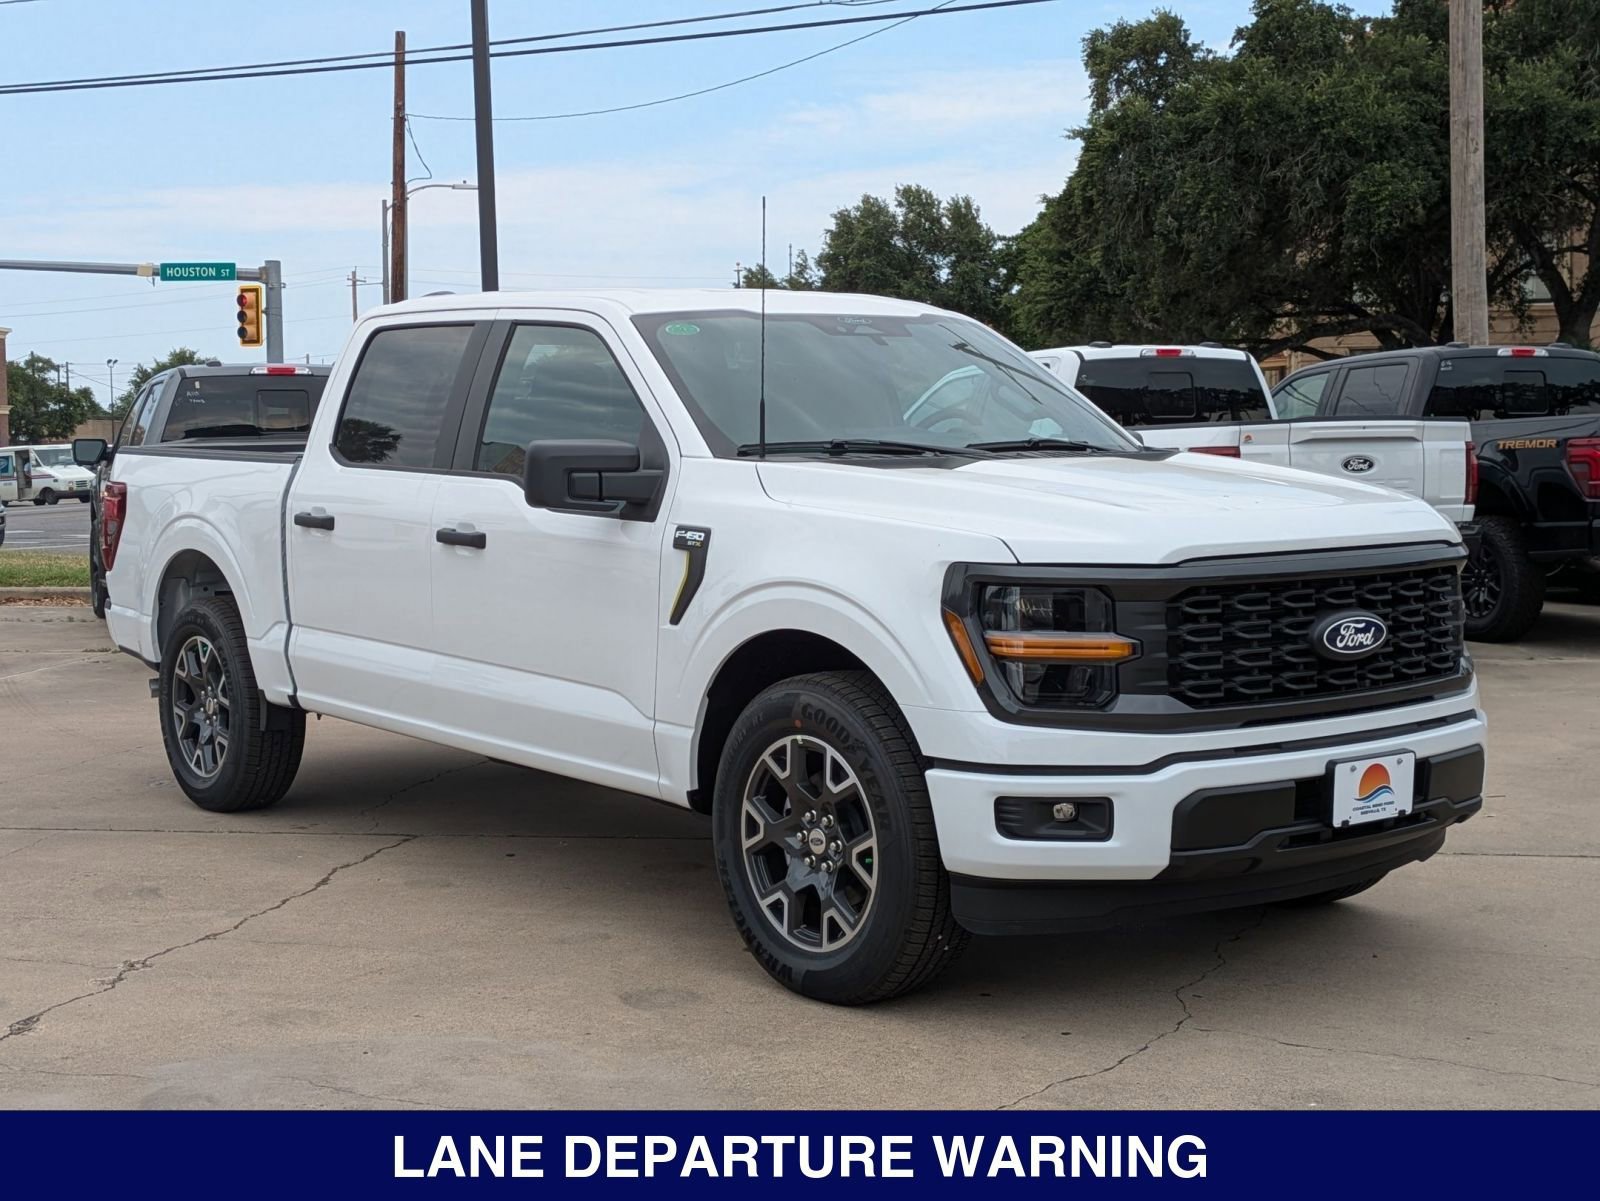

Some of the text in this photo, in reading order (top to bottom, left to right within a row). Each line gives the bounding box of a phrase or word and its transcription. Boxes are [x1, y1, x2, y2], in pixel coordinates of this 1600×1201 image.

[166, 267, 230, 277] HOUSTON ST
[1497, 439, 1557, 450] TREMOR
[1347, 459, 1370, 470] Ford
[1336, 622, 1376, 648] Ford
